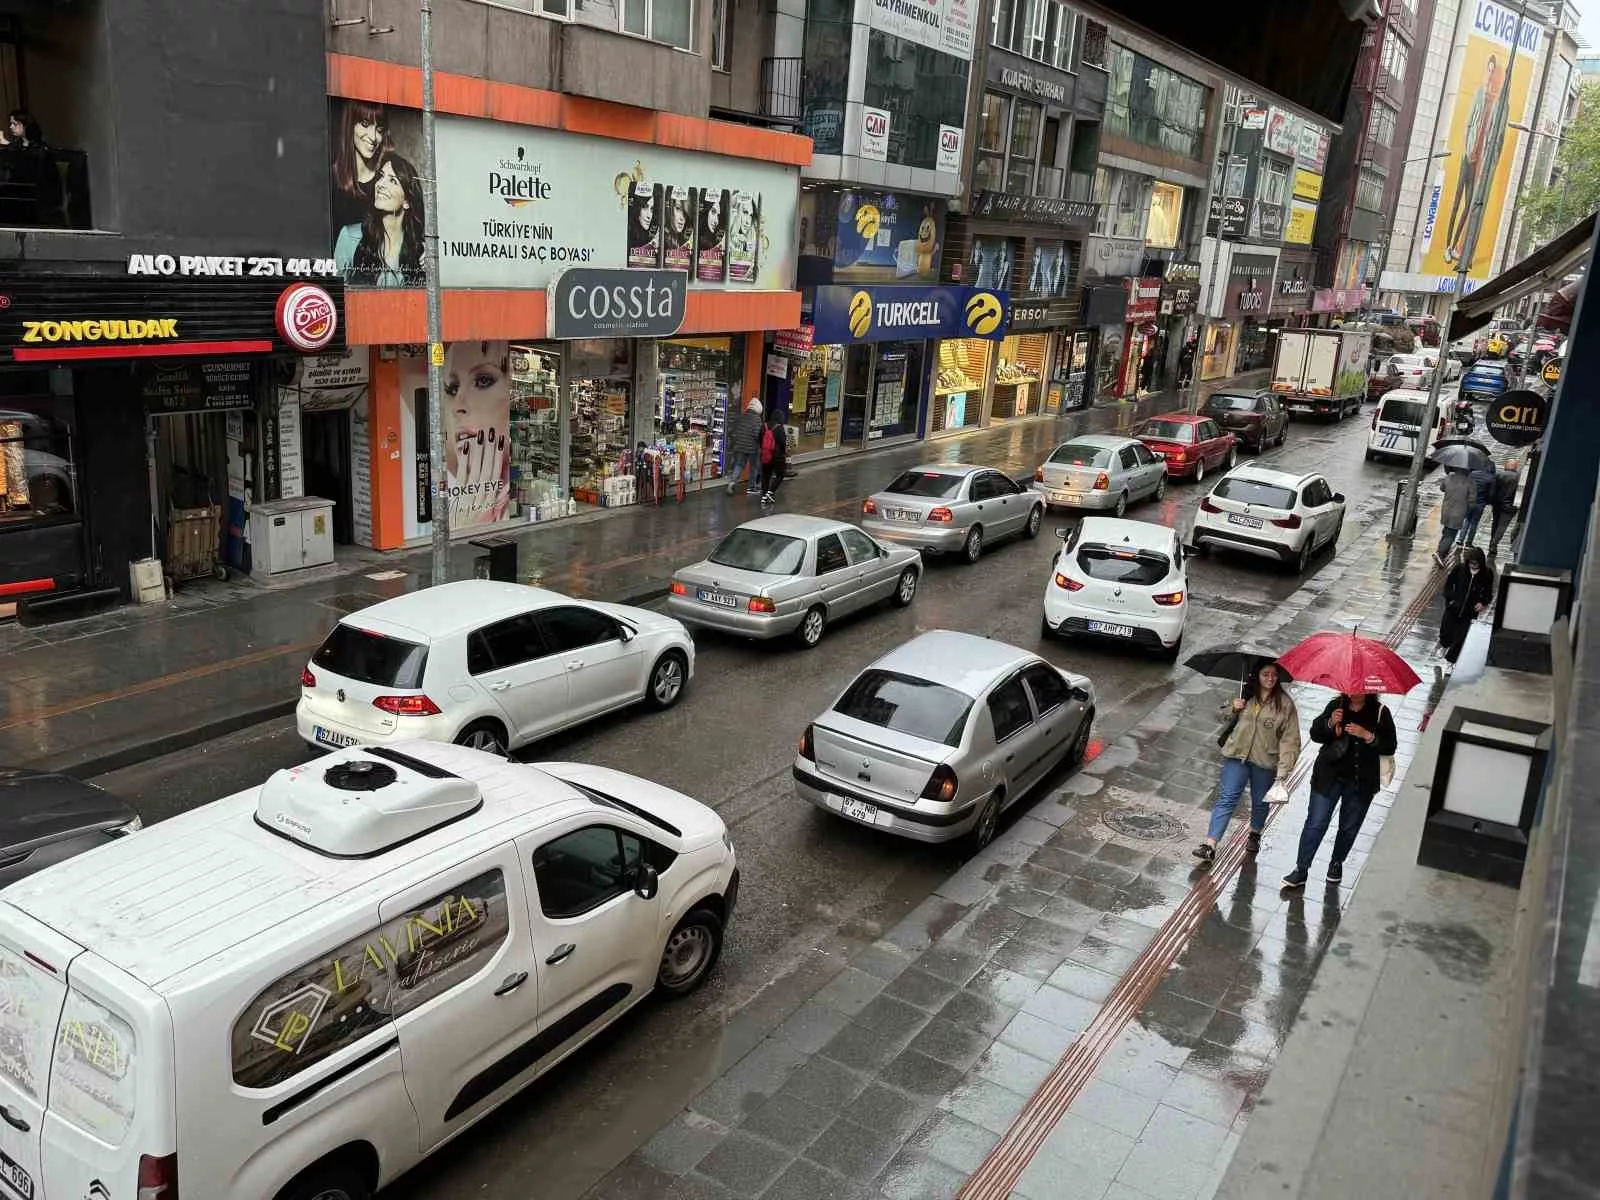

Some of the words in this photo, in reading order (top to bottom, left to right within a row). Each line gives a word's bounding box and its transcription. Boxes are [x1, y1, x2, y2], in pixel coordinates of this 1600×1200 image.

[1475, 2, 1493, 32] LC
[866, 116, 885, 135] CAN
[941, 133, 958, 151] CAN
[499, 159, 541, 175] Schwarzkopf
[489, 172, 552, 200] Palette
[482, 219, 553, 244] TÜRKİYE'NİN
[451, 243, 518, 260] NUMARALI
[522, 246, 547, 264] SAÇ
[127, 254, 176, 276] ALO
[180, 256, 246, 277] PAKET
[247, 257, 283, 278] 251
[285, 259, 311, 278] 44
[312, 259, 338, 278] 44
[566, 276, 674, 321] cossta
[876, 302, 940, 328] TURKCELL
[1014, 308, 1048, 321] ERSOY
[22, 319, 179, 343] ZONGULDAK
[484, 480, 504, 493] EYE
[12, 1166, 29, 1193] 696
